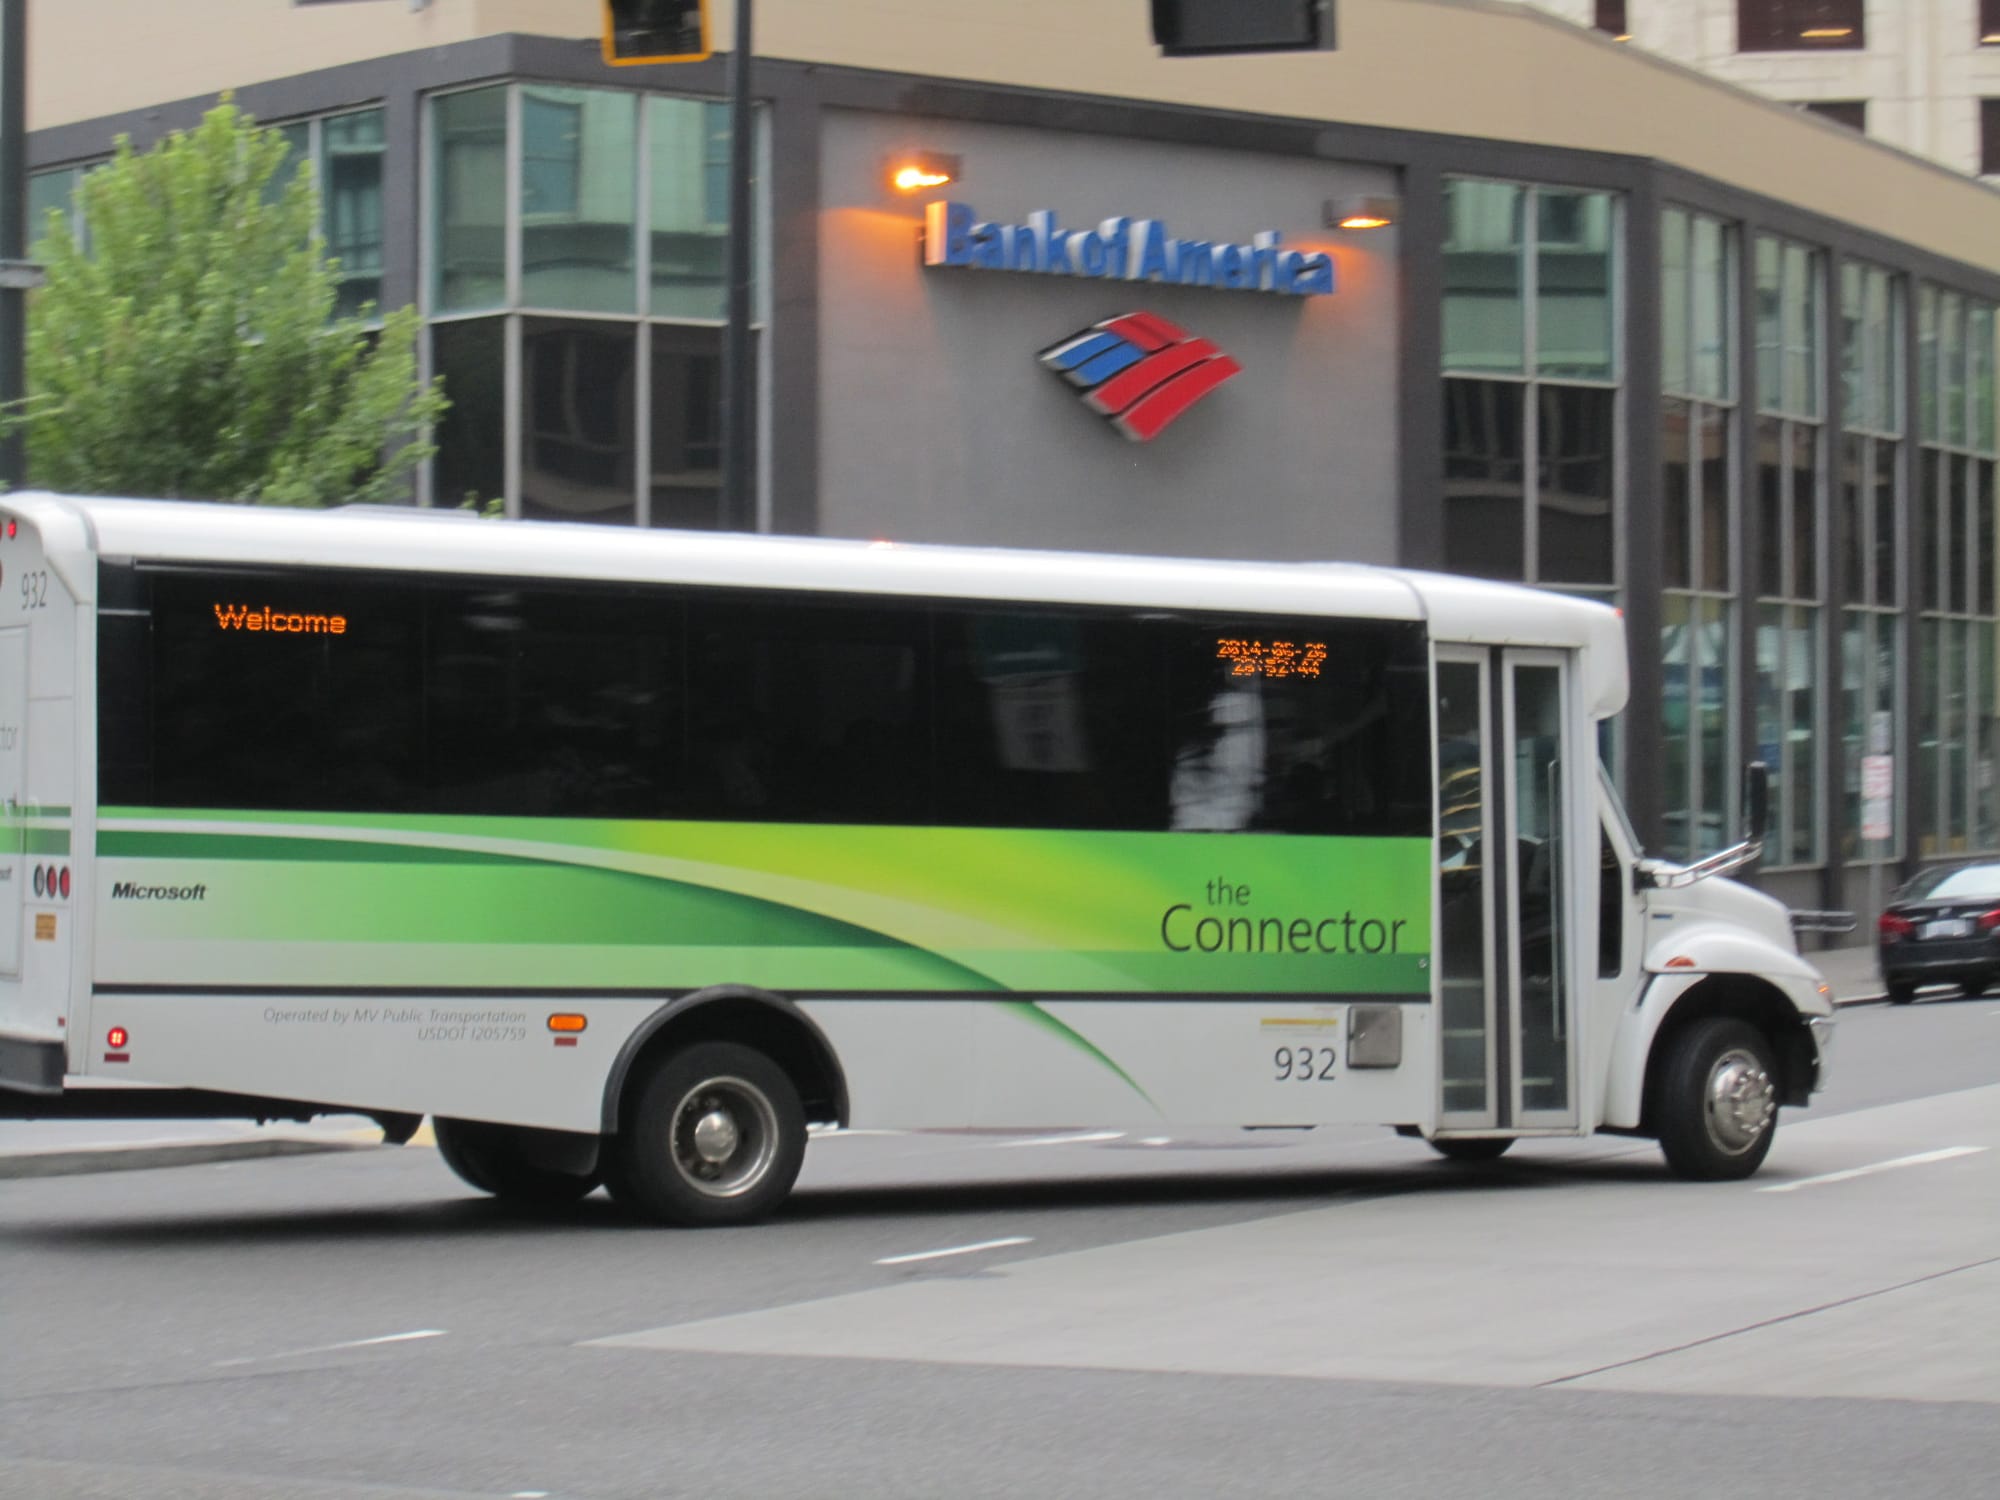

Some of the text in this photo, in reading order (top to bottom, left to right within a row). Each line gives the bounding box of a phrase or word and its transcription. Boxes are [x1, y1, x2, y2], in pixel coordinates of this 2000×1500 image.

[925, 200, 1334, 295] Bank of America
[21, 570, 47, 609] 932
[213, 603, 347, 634] Welcome
[112, 881, 206, 900] Microsoft
[1206, 876, 1251, 906] the
[1161, 904, 1407, 954] Connector
[263, 1008, 526, 1025] Operated by MV Public Transportation
[417, 1027, 467, 1041] USDOT
[1274, 1047, 1337, 1081] 932
